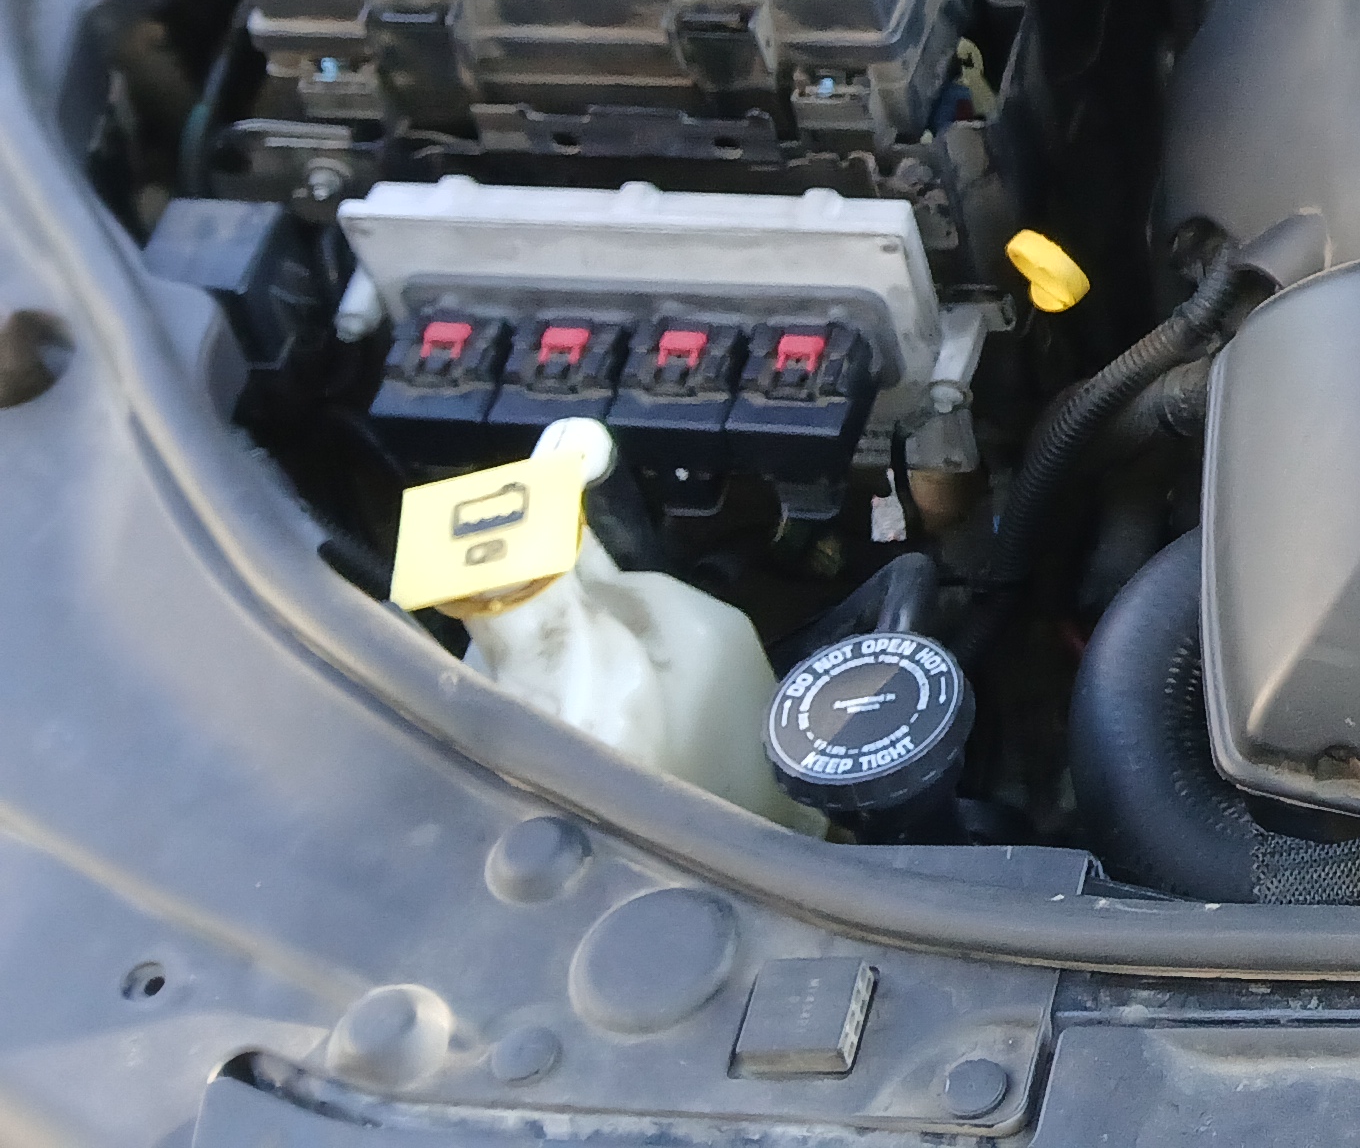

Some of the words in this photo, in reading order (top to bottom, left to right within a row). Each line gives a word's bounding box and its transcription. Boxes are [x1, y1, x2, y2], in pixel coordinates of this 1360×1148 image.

[786, 672, 814, 697] DO
[812, 645, 854, 674] NOT
[861, 638, 917, 656] OPEN
[915, 647, 948, 676] HOT
[800, 751, 853, 774] KEEP
[858, 736, 915, 772] TIGHT
